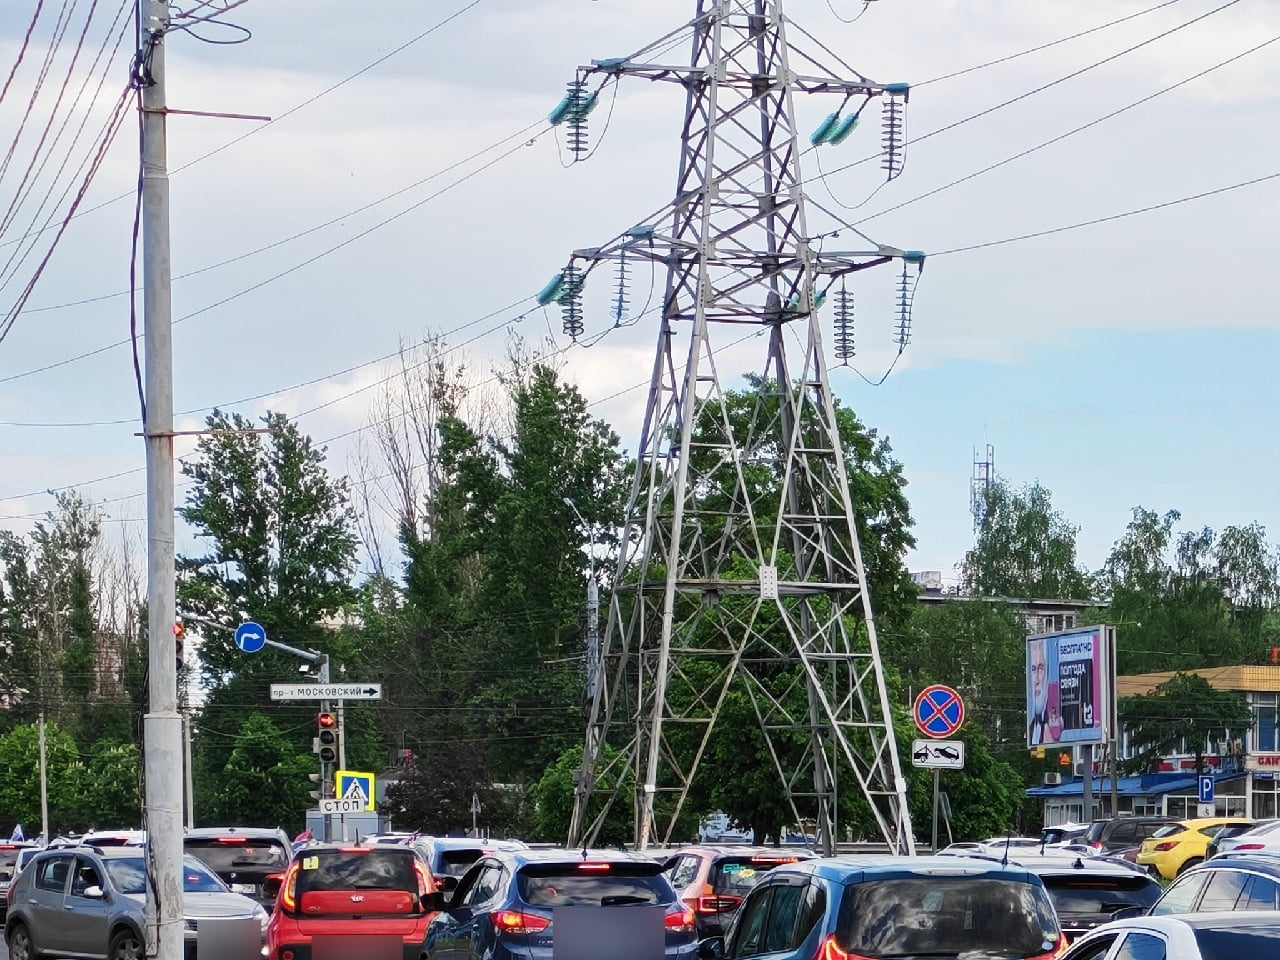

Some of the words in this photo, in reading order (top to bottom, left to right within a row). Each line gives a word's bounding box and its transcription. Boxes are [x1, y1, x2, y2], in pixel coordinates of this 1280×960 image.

[1060, 642, 1092, 655] БЕСПЛАТНО
[1060, 664, 1086, 676] ПОЛГОДА
[1060, 678, 1079, 689] СВЯЗИ
[297, 687, 361, 697] МОСКОВСКИЙ
[324, 801, 359, 811] СТОП
